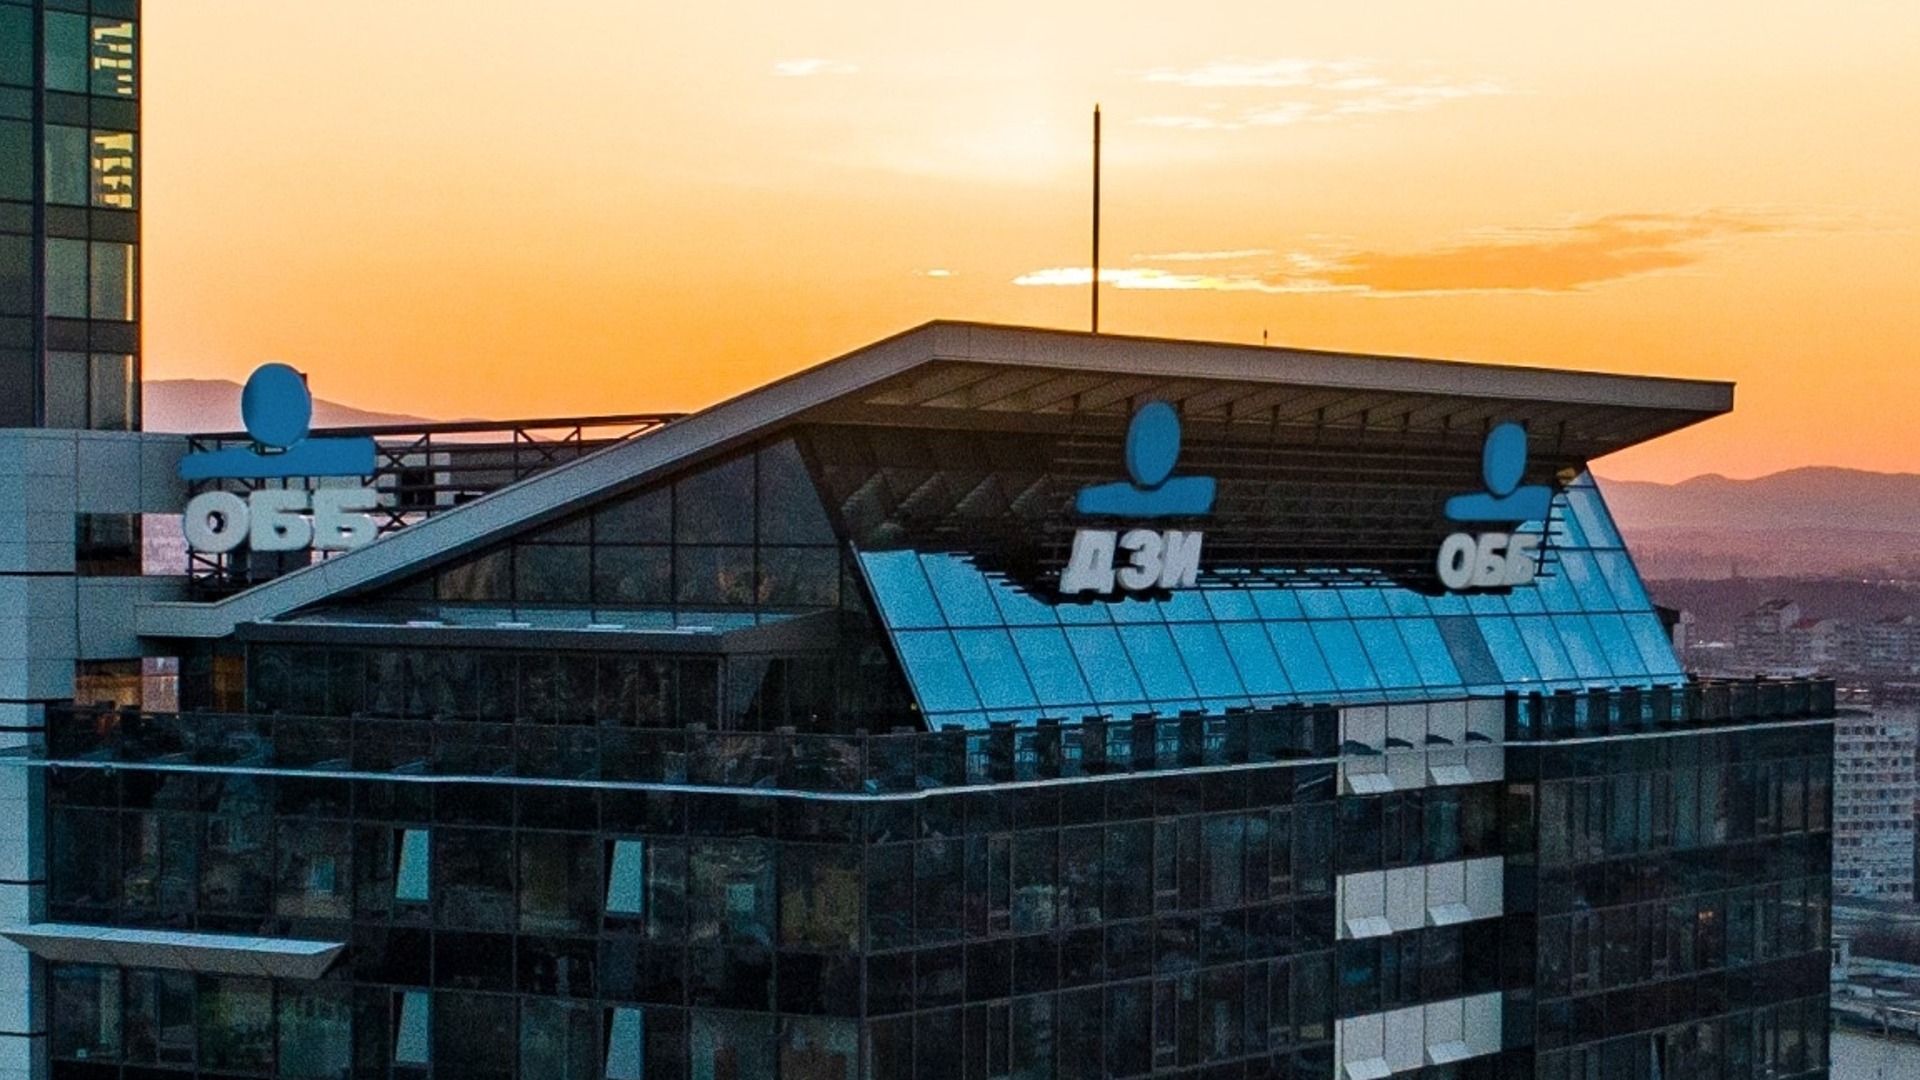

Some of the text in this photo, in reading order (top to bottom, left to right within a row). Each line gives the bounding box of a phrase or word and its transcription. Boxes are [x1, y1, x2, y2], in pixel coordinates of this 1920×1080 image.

[183, 488, 378, 552] ОББ
[1059, 529, 1203, 594] ДЗИ
[1437, 533, 1538, 589] ОББ
